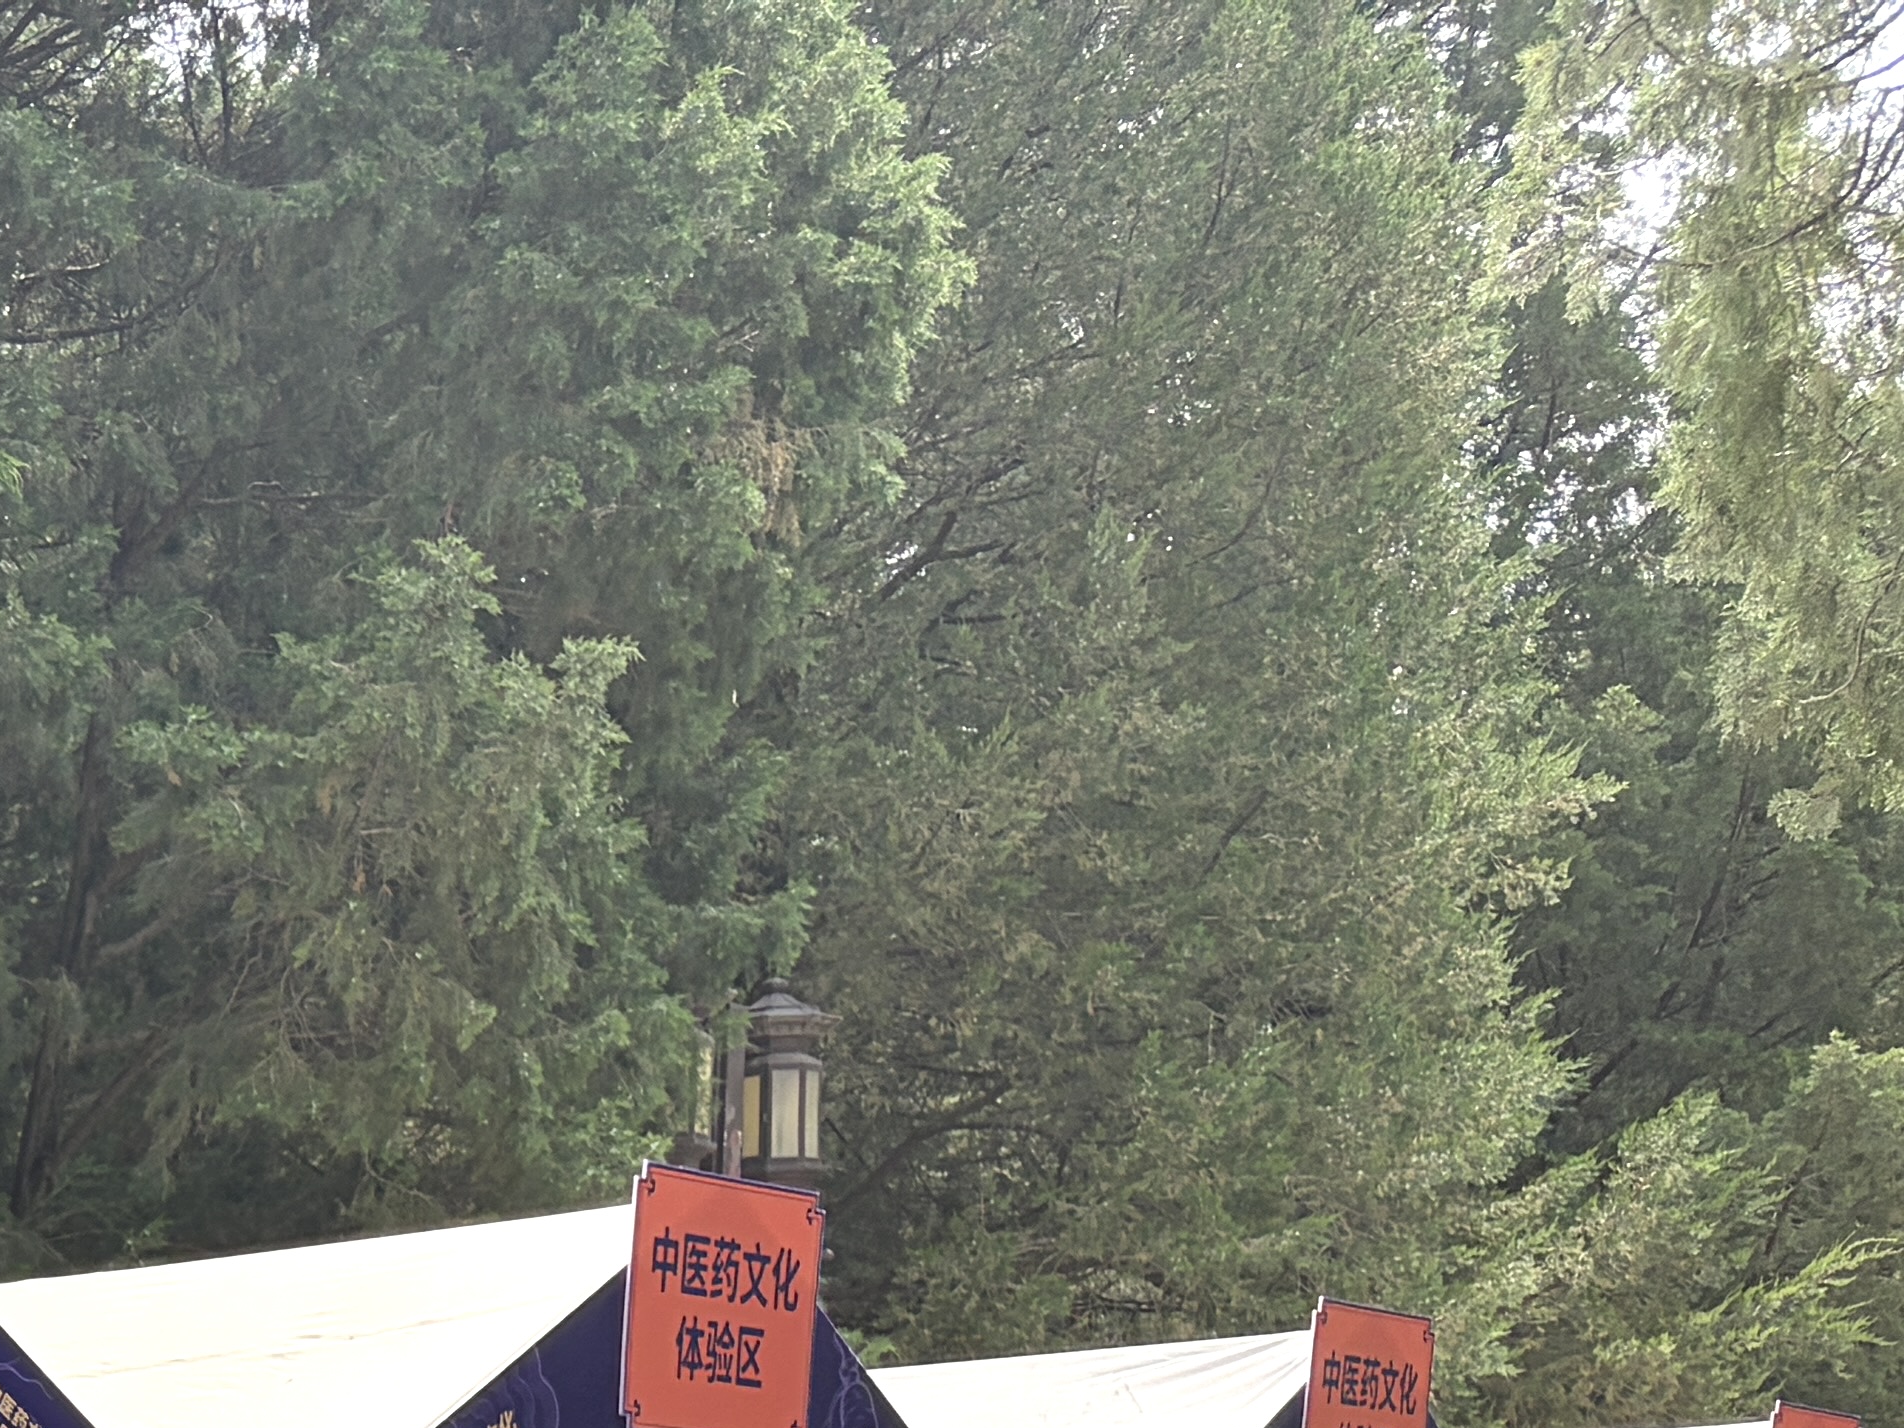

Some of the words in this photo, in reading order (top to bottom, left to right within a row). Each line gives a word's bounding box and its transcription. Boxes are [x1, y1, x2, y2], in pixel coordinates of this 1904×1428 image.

[651, 1226, 801, 1312] 中医药文化
[675, 1315, 765, 1389] 体验区
[1322, 1350, 1419, 1416] 中医药文化
